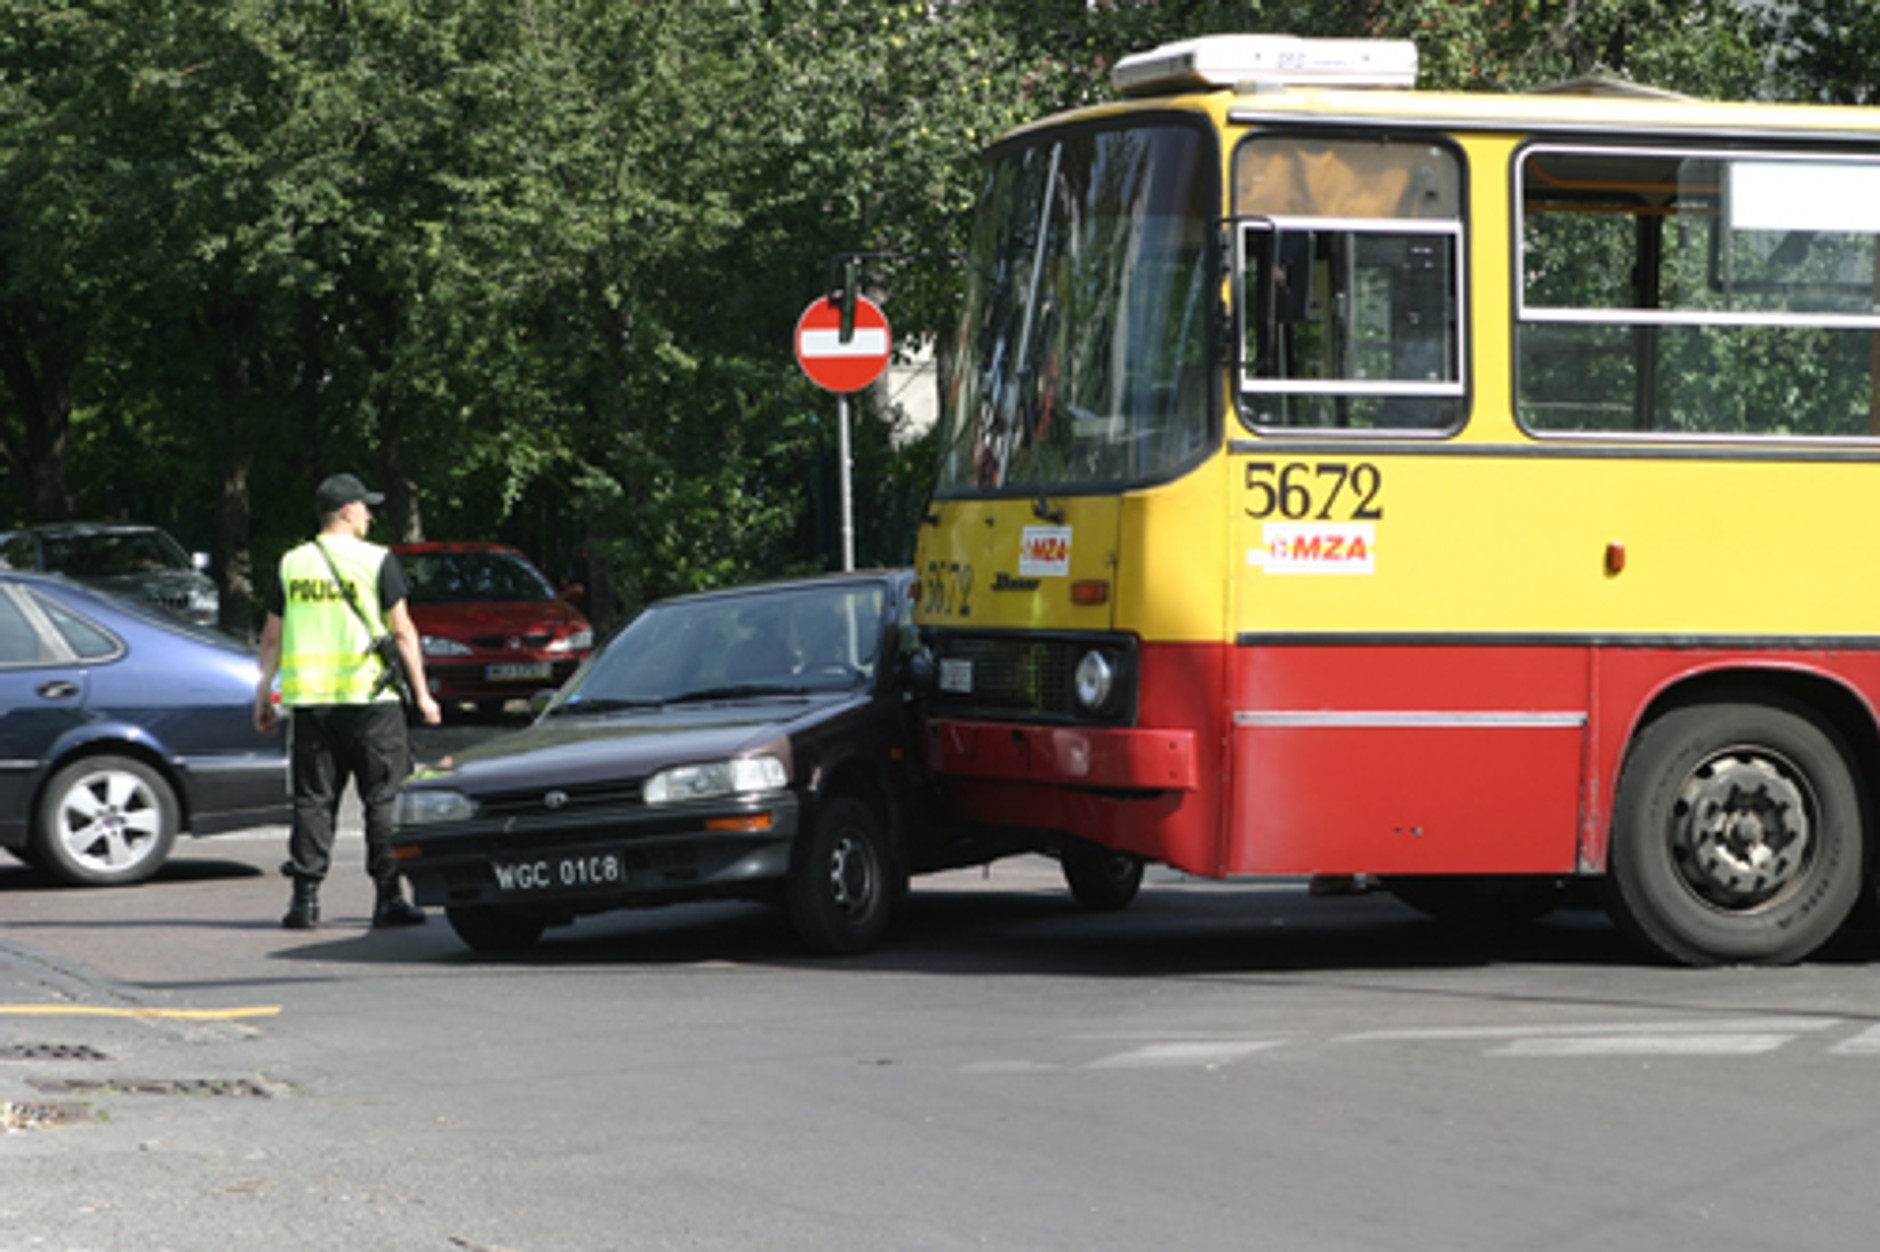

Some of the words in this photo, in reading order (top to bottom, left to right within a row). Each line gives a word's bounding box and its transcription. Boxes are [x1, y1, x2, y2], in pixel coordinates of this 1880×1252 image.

[1244, 461, 1383, 520] 5672
[1030, 537, 1066, 562] MZA
[1293, 534, 1367, 561] MZA
[492, 860, 550, 890] WGC
